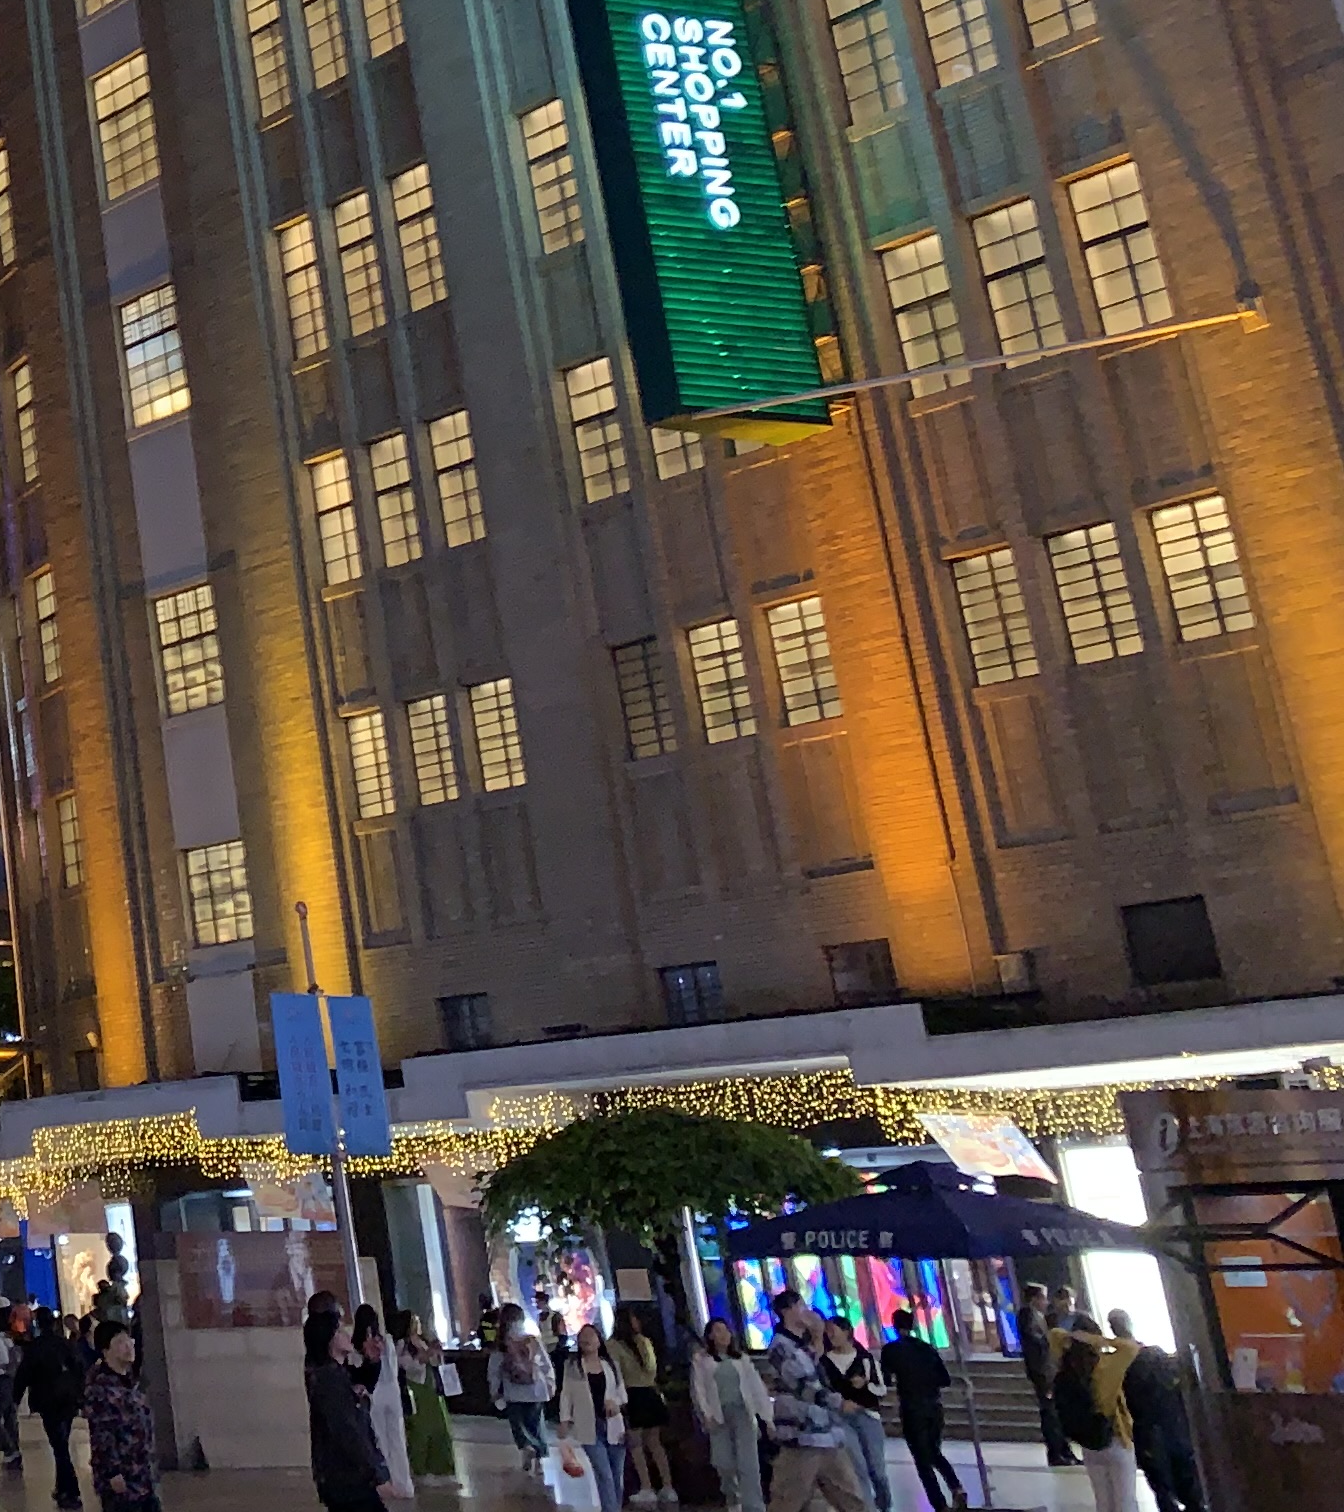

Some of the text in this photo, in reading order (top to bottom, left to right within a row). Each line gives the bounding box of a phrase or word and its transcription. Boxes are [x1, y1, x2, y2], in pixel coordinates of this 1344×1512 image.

[641, 12, 699, 178] CENTER
[672, 15, 742, 230] SHOPPING
[703, 18, 749, 111] NO.1
[805, 1230, 870, 1249] POLICE
